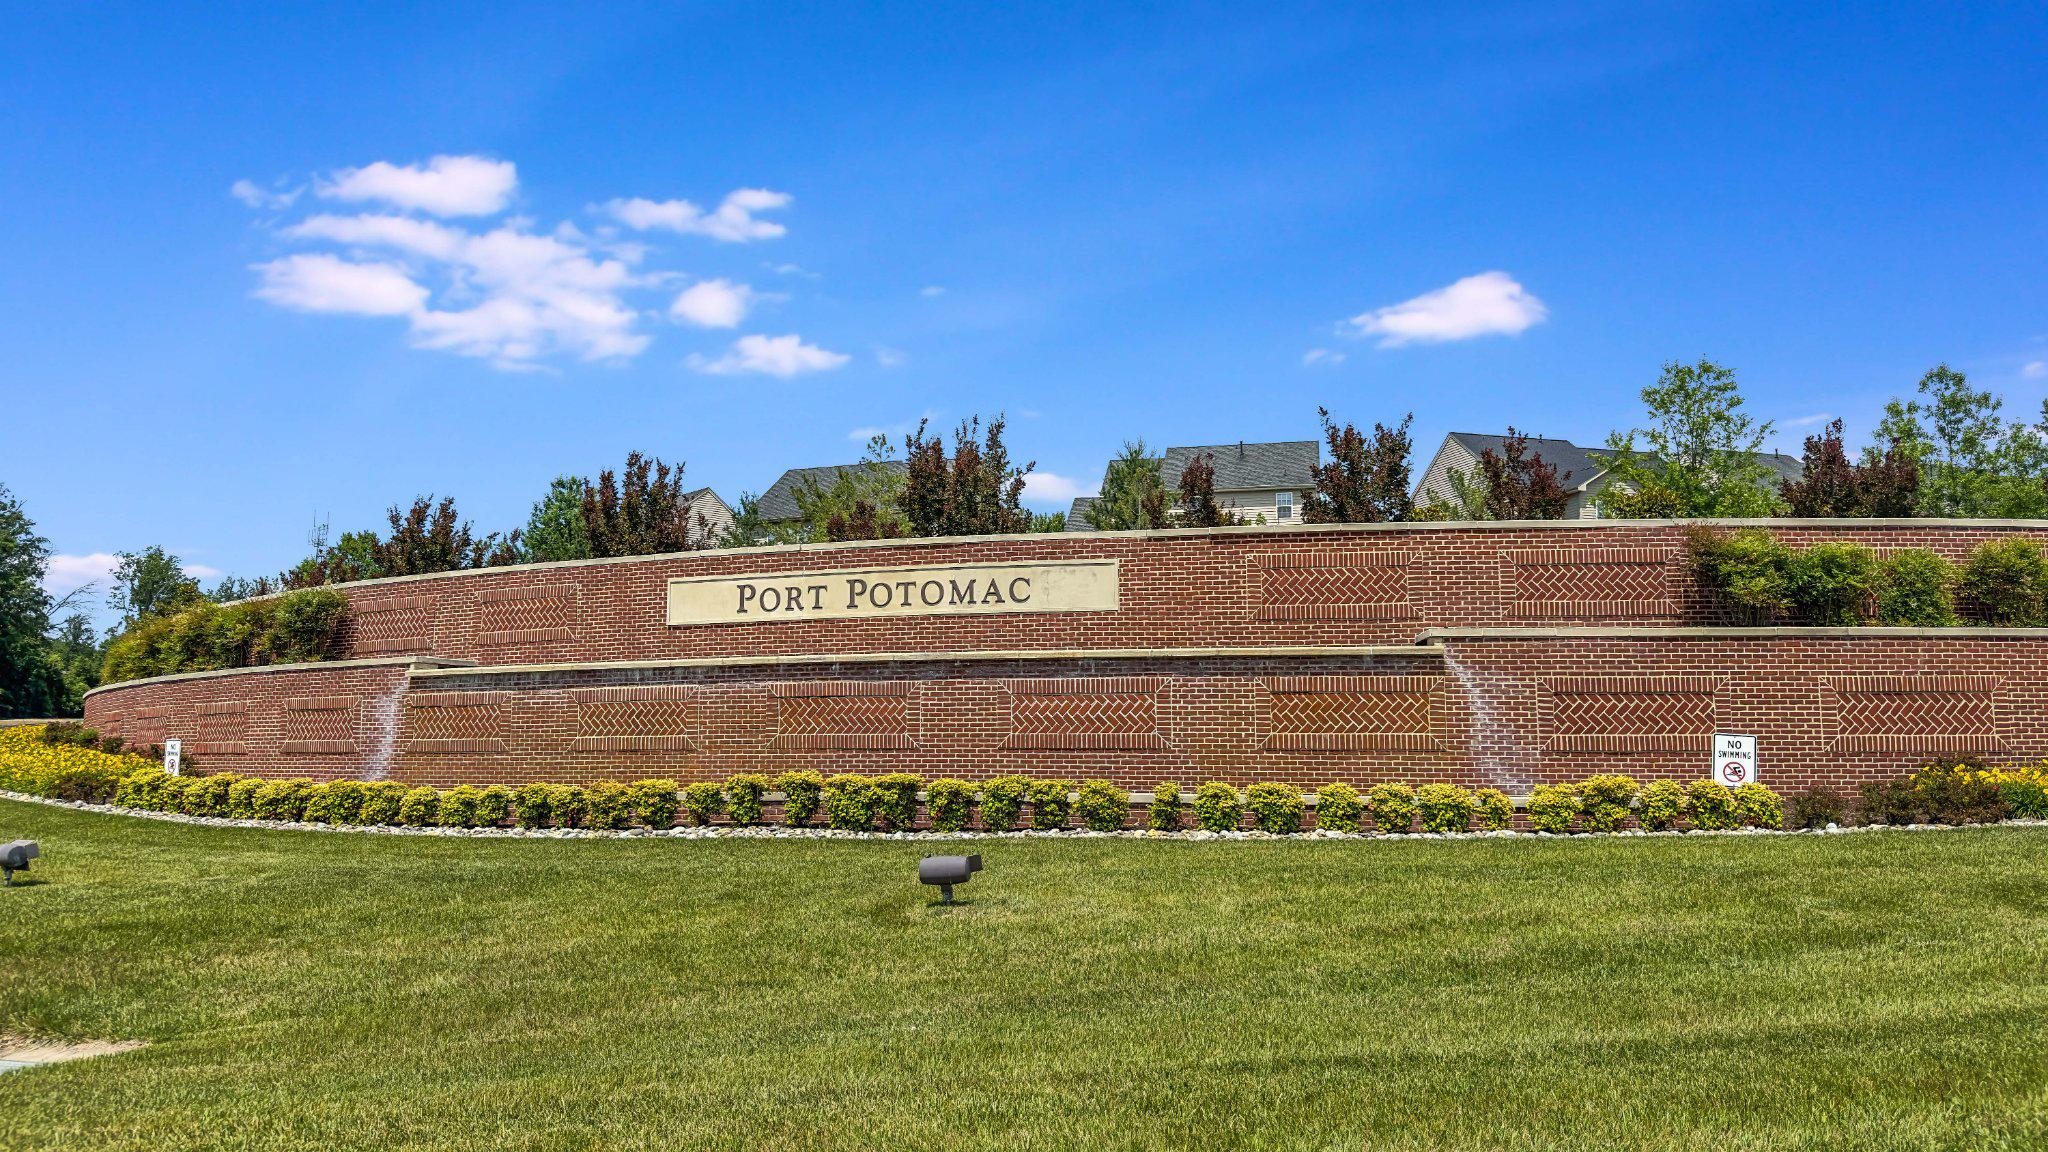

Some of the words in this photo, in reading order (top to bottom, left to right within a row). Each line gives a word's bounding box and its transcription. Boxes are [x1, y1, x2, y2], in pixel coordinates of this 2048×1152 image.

[736, 584, 828, 613] PORT
[846, 577, 1031, 609] POTOMAC
[1727, 740, 1742, 749] NO
[1718, 750, 1751, 759] SWIMMING
